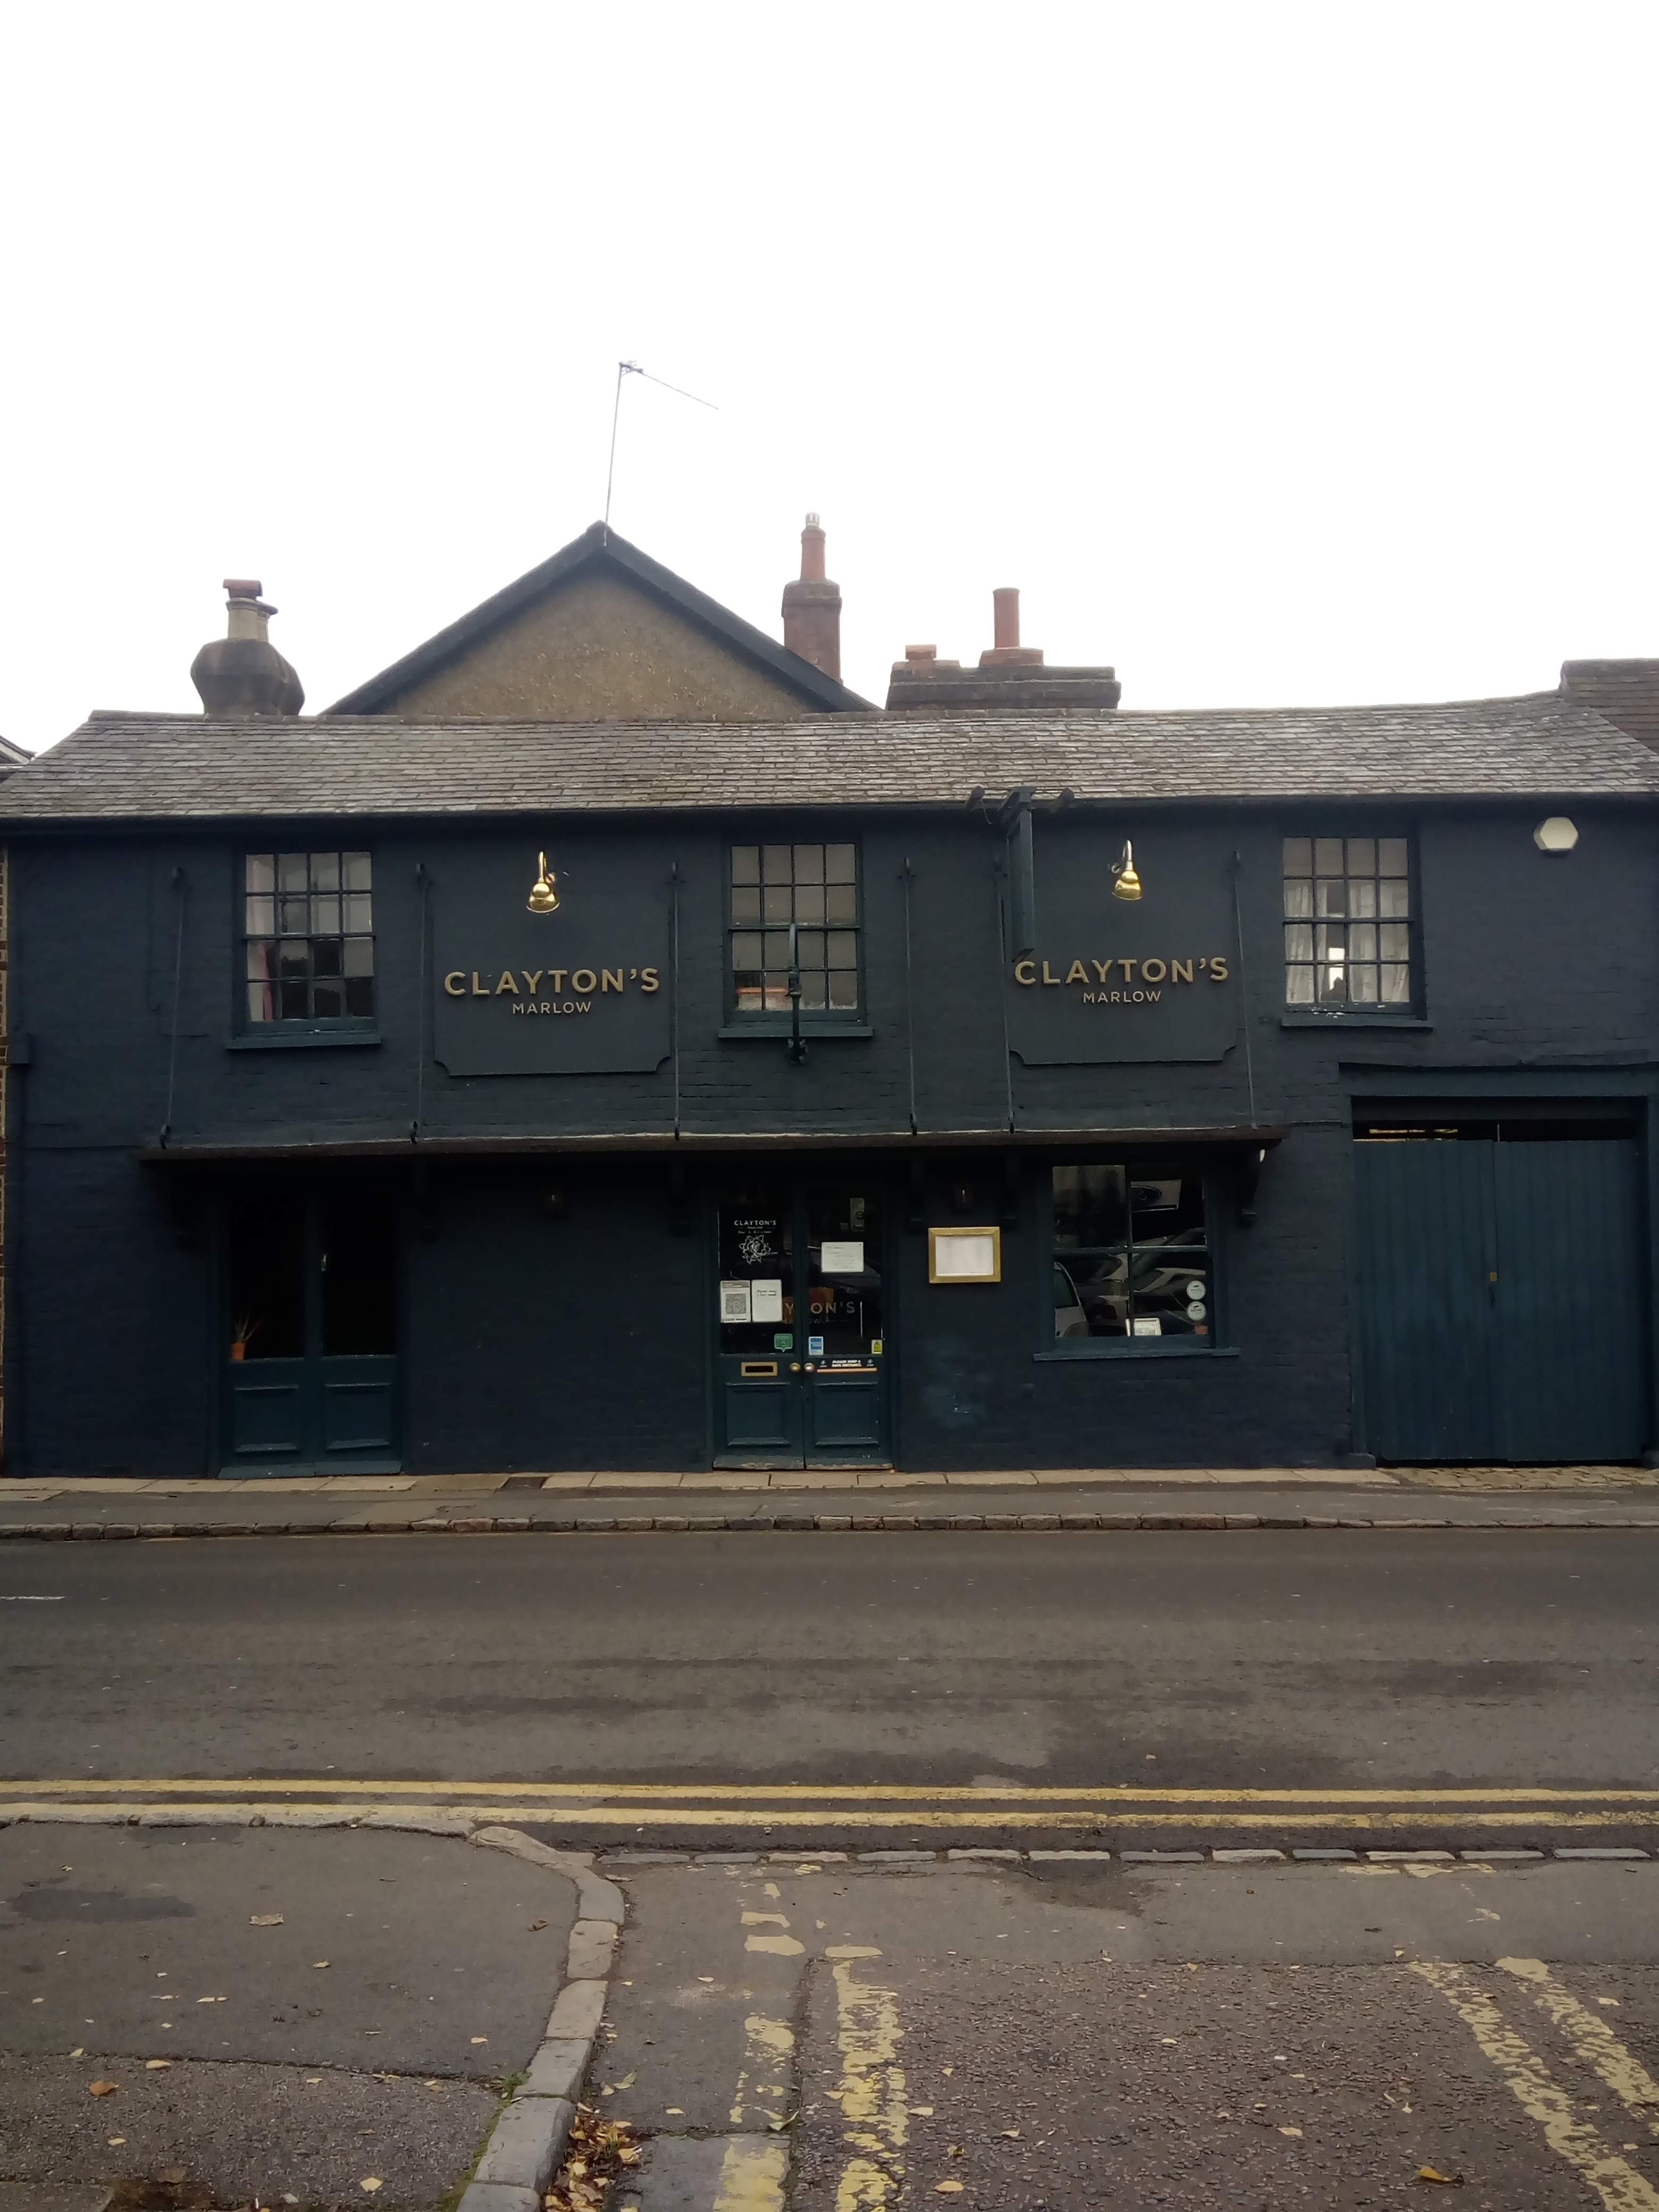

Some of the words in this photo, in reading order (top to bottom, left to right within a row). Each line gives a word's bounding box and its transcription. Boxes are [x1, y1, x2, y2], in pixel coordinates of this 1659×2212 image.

[444, 967, 660, 996] CLAYTON'S
[1014, 957, 1229, 985] CLAYTON'S
[1083, 990, 1161, 1003] MARLOW
[512, 1001, 592, 1015] MARLOW
